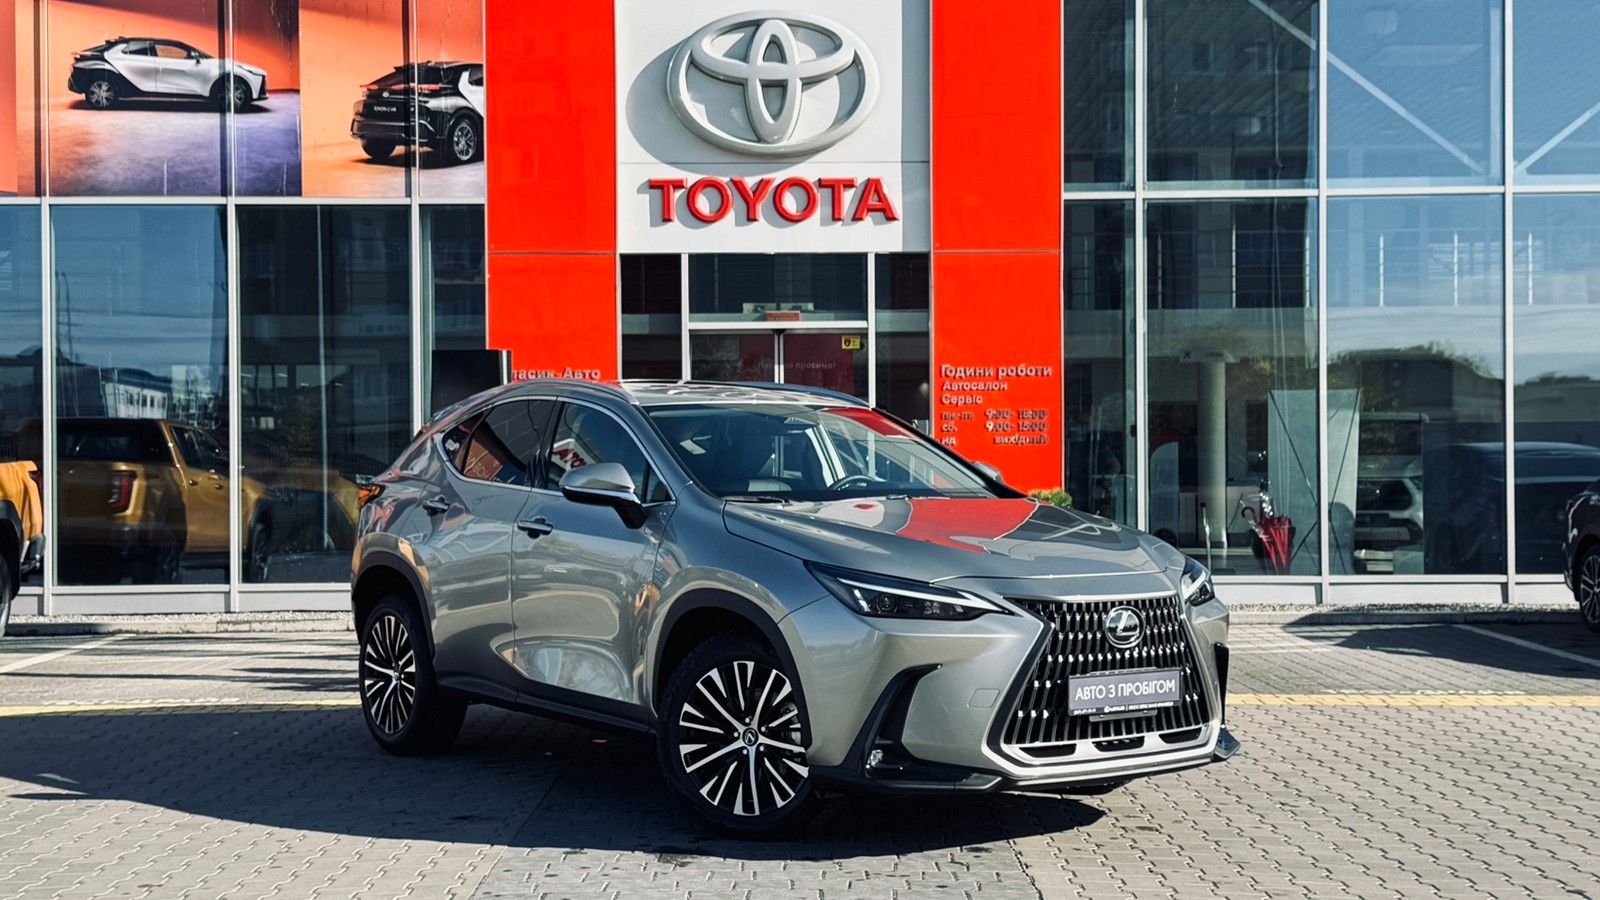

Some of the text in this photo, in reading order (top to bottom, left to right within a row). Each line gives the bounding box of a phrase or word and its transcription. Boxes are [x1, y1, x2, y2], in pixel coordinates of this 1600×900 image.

[648, 177, 900, 223] TOYOTA
[941, 364, 1053, 379] Години роботи
[942, 381, 1008, 391] Автосалон
[941, 394, 983, 406] Сервіс
[1075, 685, 1106, 701] АВТО
[1118, 679, 1176, 697] ПРОБІГОМ
